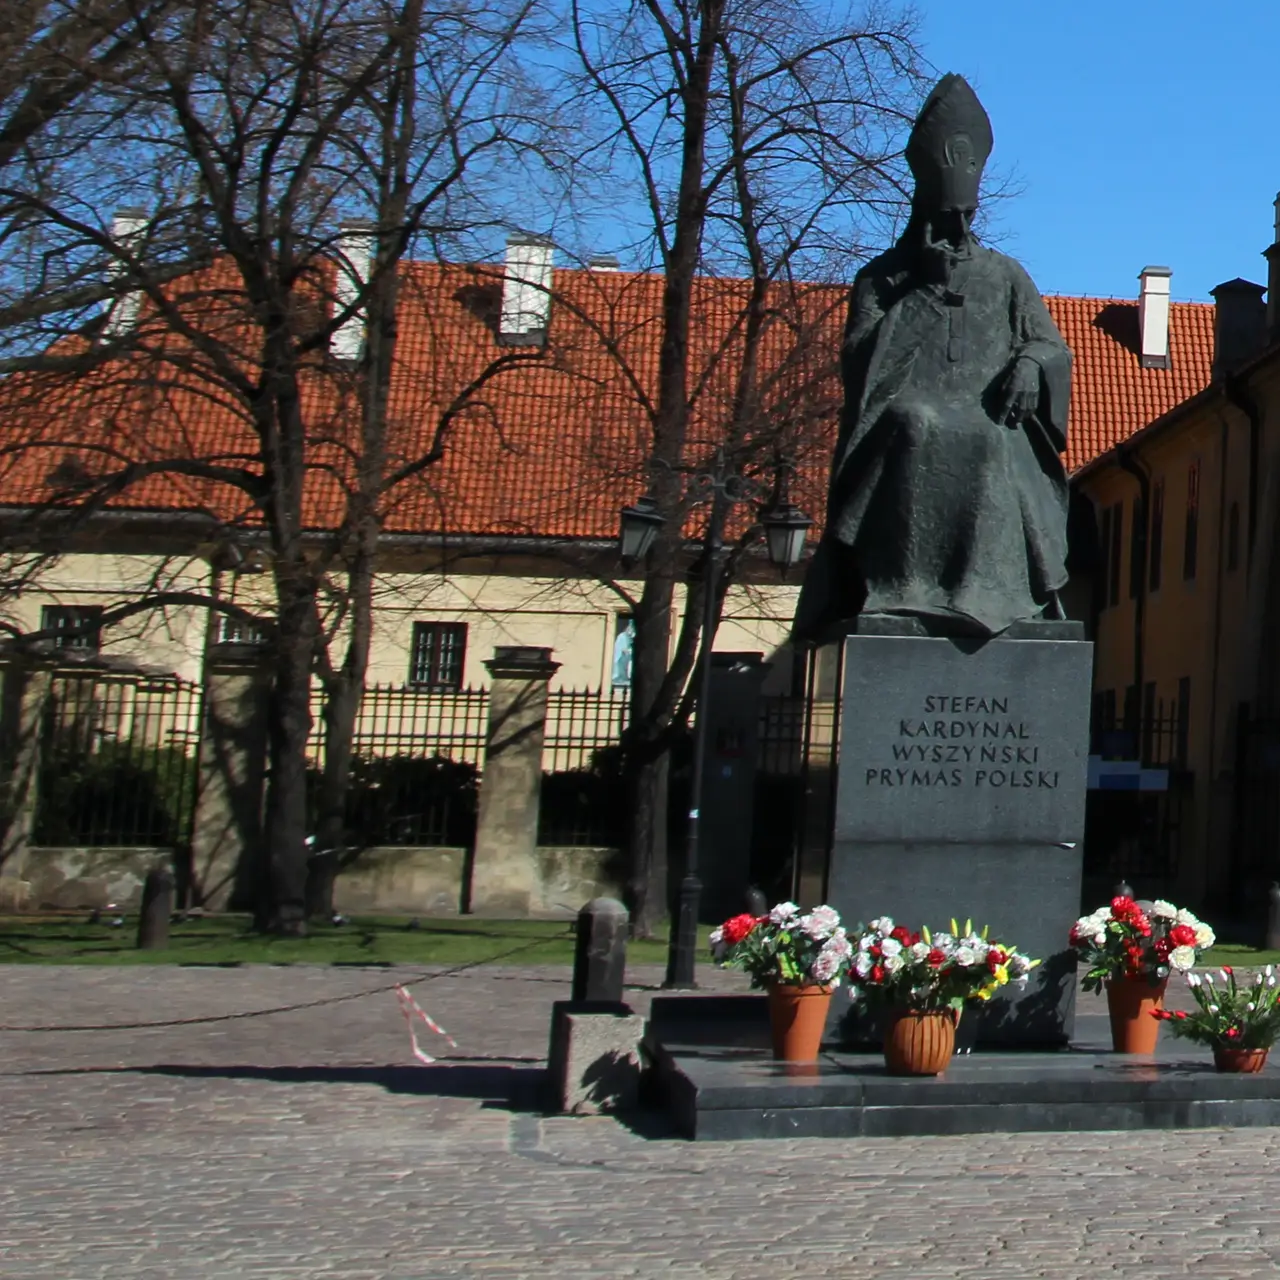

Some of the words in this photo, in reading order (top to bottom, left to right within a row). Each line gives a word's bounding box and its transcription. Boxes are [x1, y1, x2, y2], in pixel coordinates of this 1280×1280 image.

[924, 695, 1009, 714] STEFAN
[892, 741, 1039, 764] WYSZYŃSKI
[865, 769, 962, 788] PRYMAS
[974, 769, 1060, 789] POLSKI
